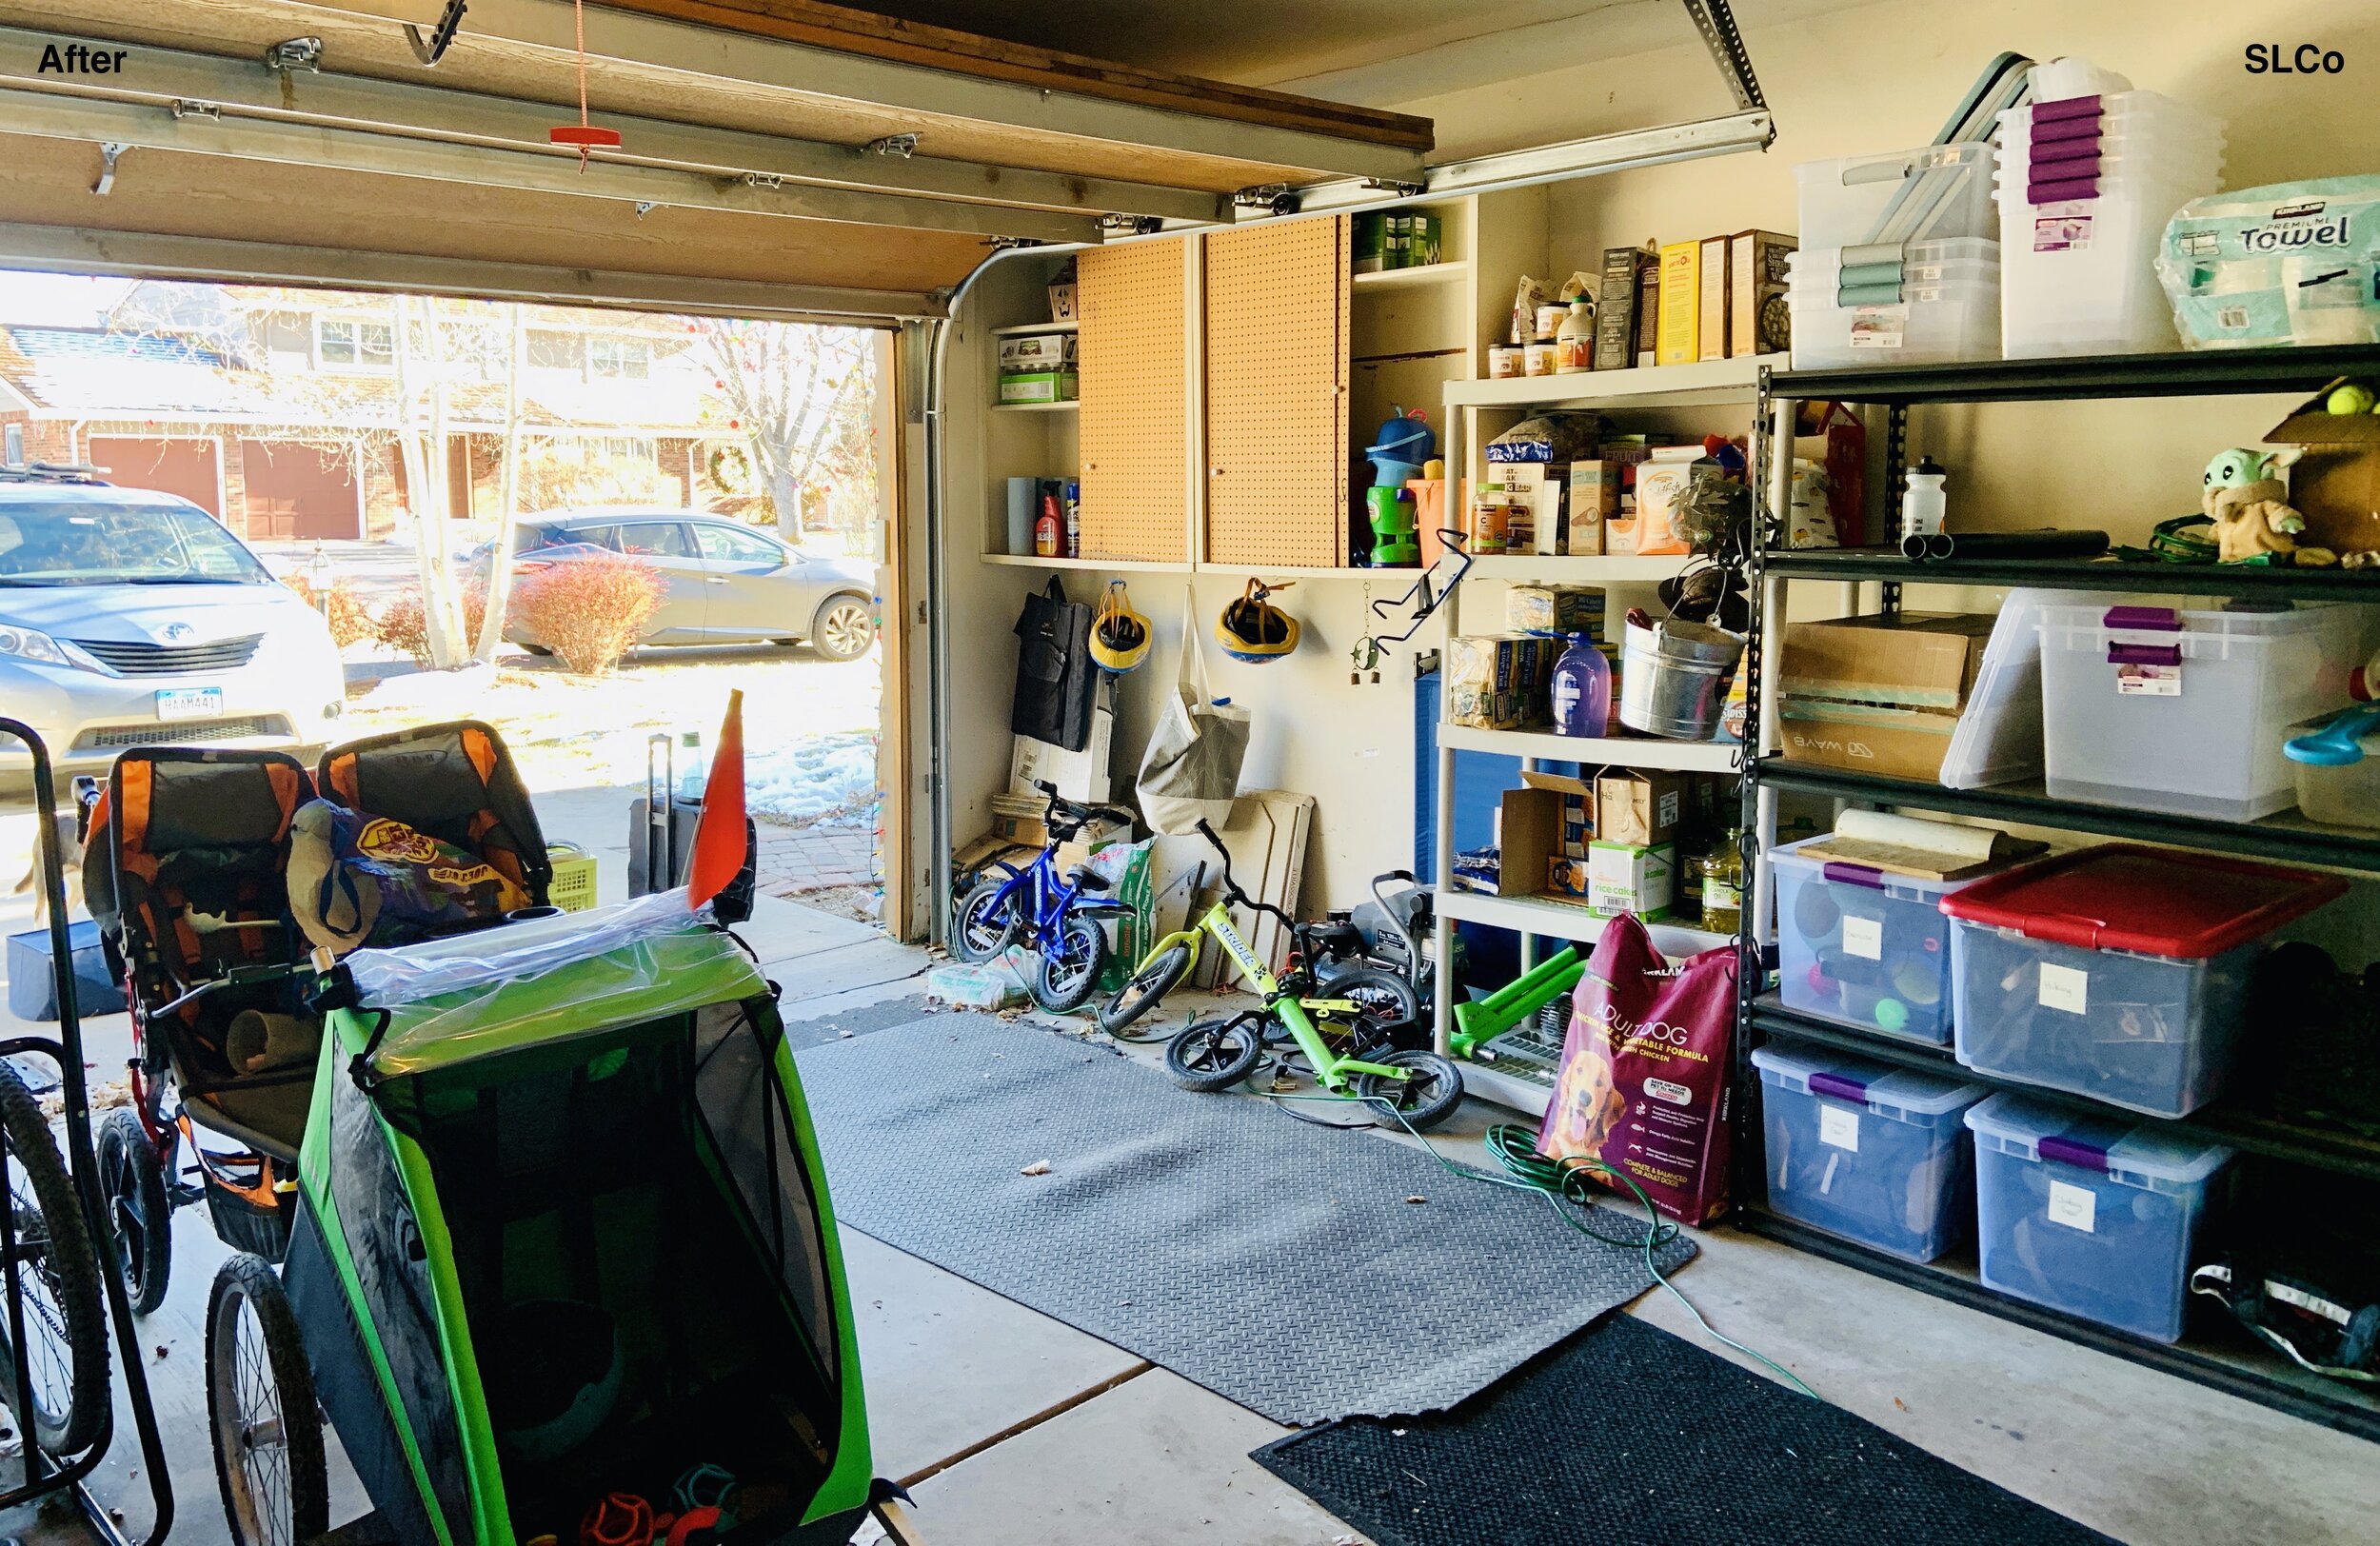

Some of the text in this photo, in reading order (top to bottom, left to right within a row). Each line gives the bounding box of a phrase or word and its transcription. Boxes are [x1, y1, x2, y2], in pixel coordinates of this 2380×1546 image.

[2240, 216, 2350, 250] Towel
[1605, 451, 1636, 463] FRUIT
[1721, 707, 1747, 719] SWISS
[1595, 883, 1637, 897] rice cakes
[1217, 922, 1256, 968] STRIDER
[1594, 1001, 1688, 1045] ADULT DOG
[1639, 1048, 1671, 1062] CHICKEN
[1666, 1045, 1709, 1063] FORMULA
[1721, 1086, 1731, 1121] KIRKLAND
[1623, 1158, 1651, 1173] COMPLETE
[1656, 1169, 1688, 1183] BALANCED
[1631, 1166, 1679, 1188] FOR ADULT DOGS
